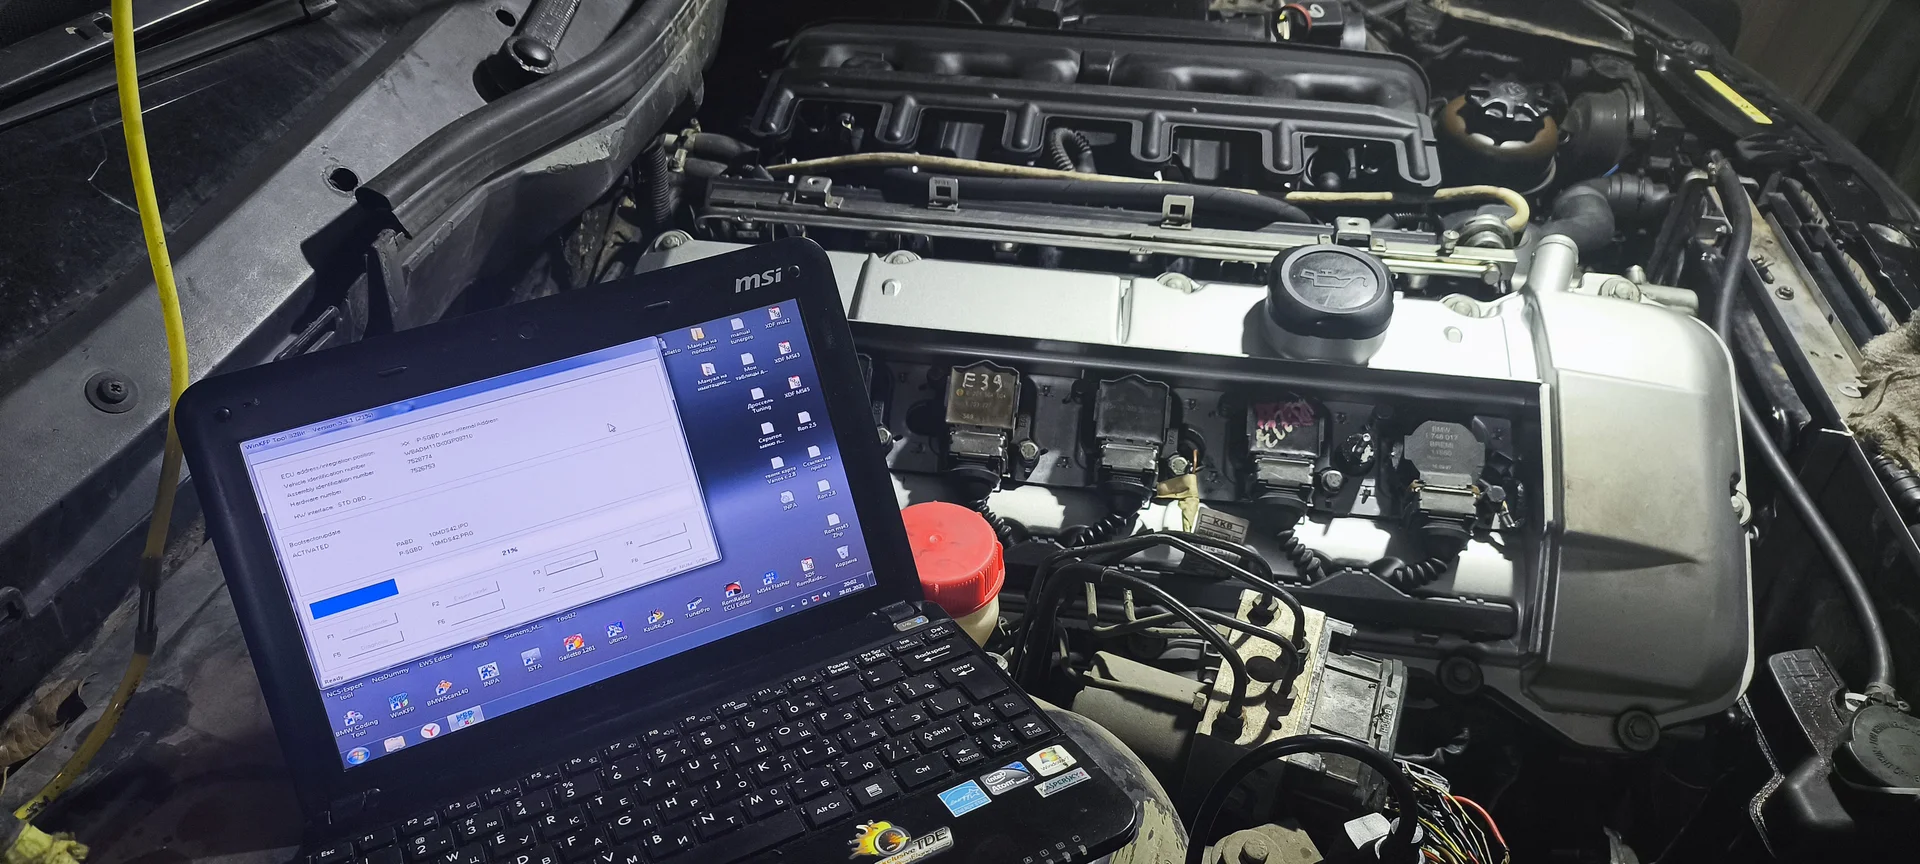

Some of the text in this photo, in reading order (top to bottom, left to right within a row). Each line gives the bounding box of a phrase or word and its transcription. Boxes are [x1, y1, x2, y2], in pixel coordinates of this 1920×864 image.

[736, 268, 781, 293] msi
[731, 329, 750, 338] manual
[731, 335, 753, 344] tunerpro
[663, 348, 681, 356] alletto
[962, 372, 1002, 392] E39
[752, 405, 771, 413] Tuning
[245, 440, 271, 450] WinKFP
[273, 434, 287, 444] Tool
[312, 421, 337, 433] Version
[281, 470, 294, 480] ECU
[284, 478, 306, 489] Vehicle
[346, 462, 366, 473] number
[287, 485, 314, 499] Assembly
[350, 470, 375, 481] number
[290, 489, 342, 507] Hardware number
[289, 528, 341, 548] Bootsectorupdate
[293, 543, 330, 558] ACTIVATED
[501, 546, 518, 556] 21%
[835, 558, 857, 568] Корзина
[772, 581, 790, 589] Flasher
[844, 579, 857, 587] 20:02
[722, 594, 751, 606] RomRaider
[556, 612, 577, 623] Tool32
[685, 606, 711, 619] TunerPro
[930, 629, 949, 638] ScrLk
[861, 651, 873, 660] Prt
[915, 645, 950, 659] Backspace
[419, 653, 453, 669] EWS Editor
[827, 660, 849, 671] Pause
[527, 663, 543, 672] ISTA
[830, 664, 851, 675] Break
[951, 662, 971, 673] Enter
[324, 674, 344, 686] Ready
[371, 666, 410, 684] NcsDummy
[793, 675, 806, 683] F12
[483, 677, 501, 688] INPA
[340, 691, 354, 701] tool
[426, 687, 469, 707] BMWScan140
[758, 688, 771, 697] F11
[722, 701, 736, 710] F10
[1004, 701, 1015, 709] Fn
[389, 706, 415, 719] WinKFP
[335, 718, 379, 738] BMW Coding
[971, 717, 992, 728] PgUp
[351, 729, 367, 739] Tool
[932, 726, 951, 737] Shift
[1025, 726, 1042, 737] End
[992, 739, 1012, 751] PgDn
[956, 752, 980, 765] Home
[916, 765, 930, 773] Ctrl
[991, 779, 1015, 793] Atom
[449, 802, 461, 810] F3
[407, 818, 418, 826] F2
[364, 834, 374, 842] F1
[913, 829, 948, 850] TDE
[321, 849, 335, 857] Esc
